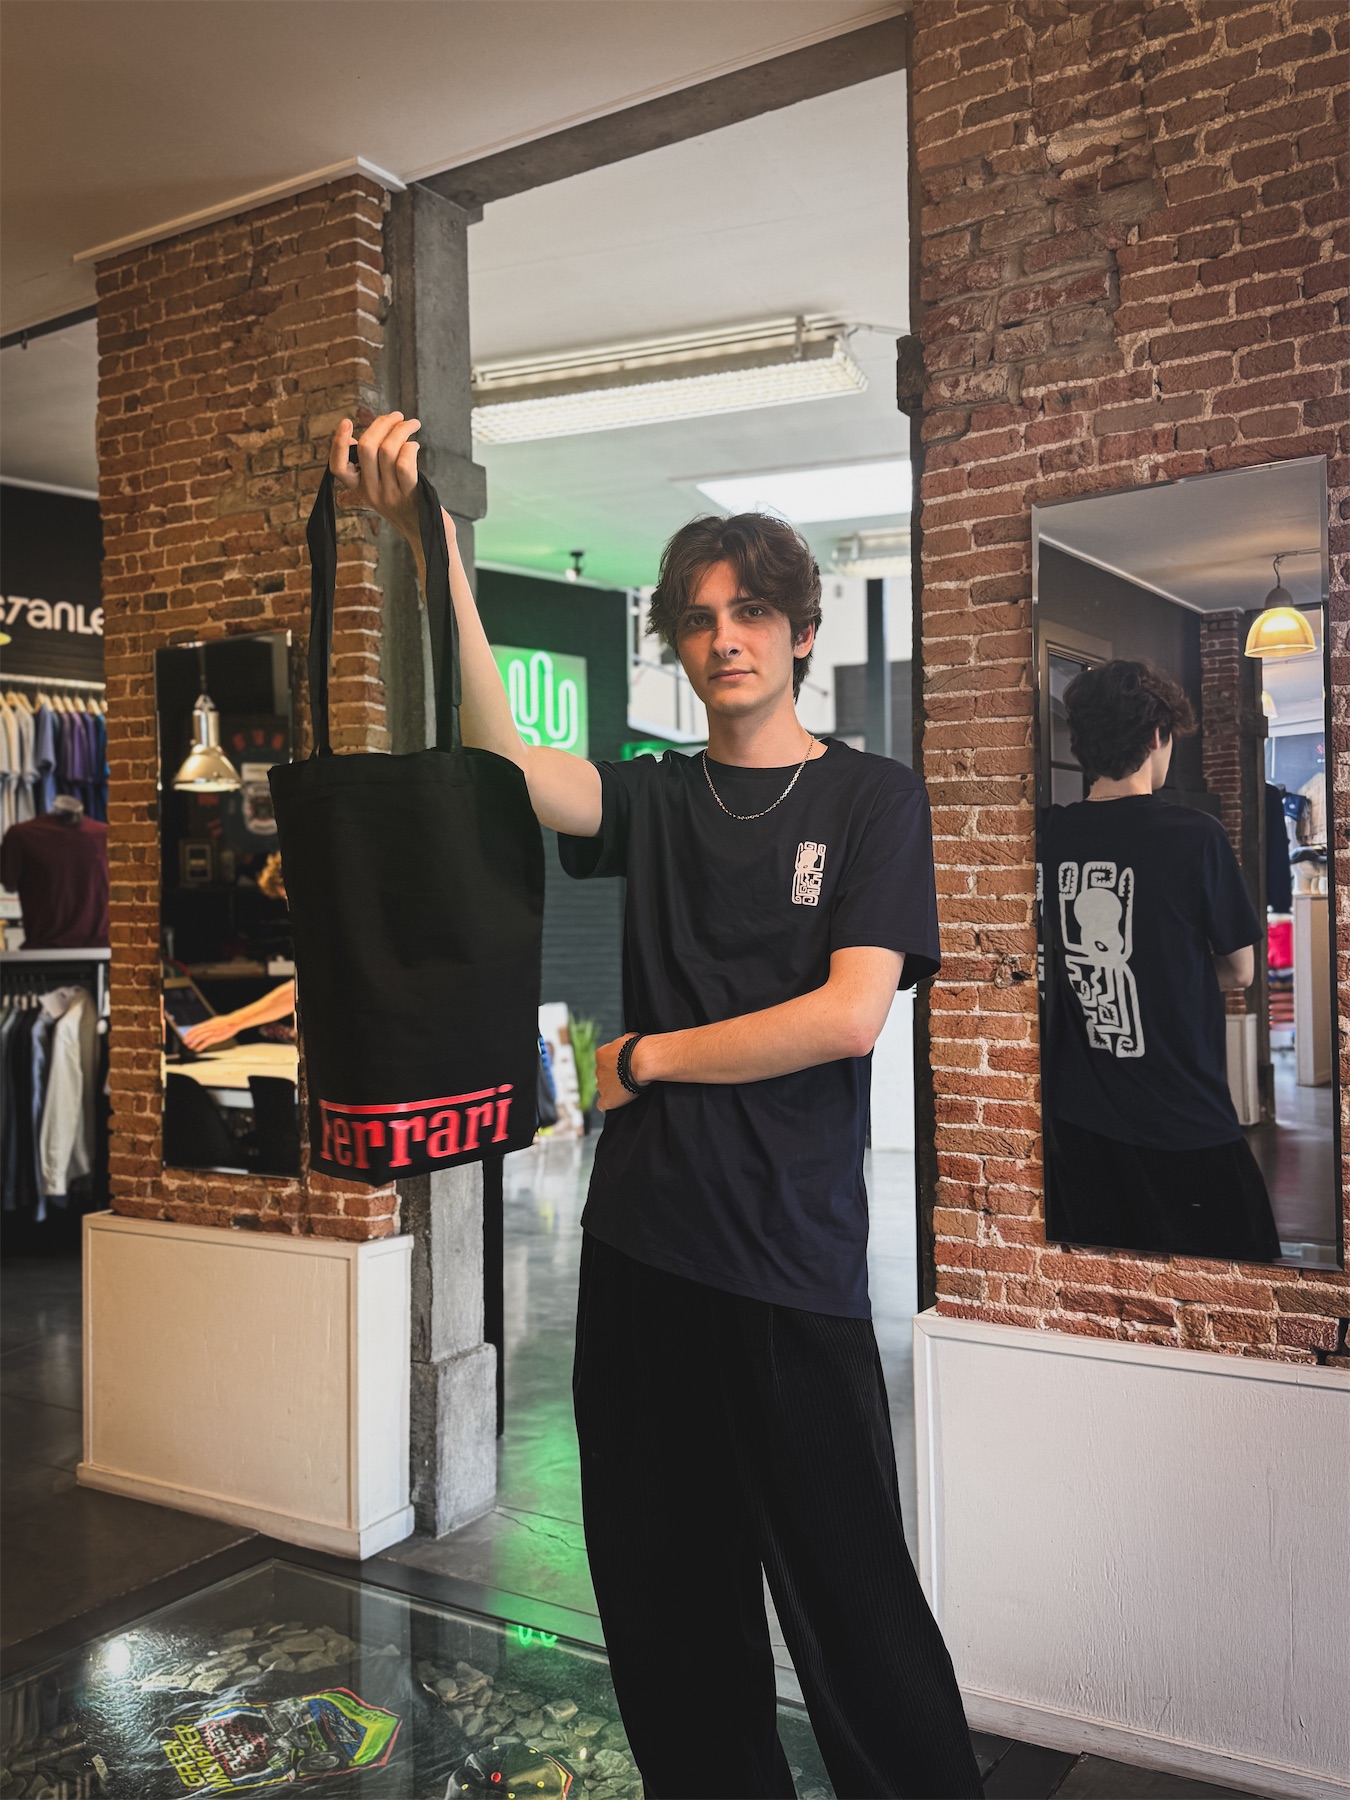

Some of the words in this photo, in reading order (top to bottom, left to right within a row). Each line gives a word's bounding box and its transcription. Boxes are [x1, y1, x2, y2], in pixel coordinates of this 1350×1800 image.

[319, 1083, 514, 1169] Ferrari
[160, 1740, 206, 1787] GREEN
[174, 1723, 234, 1789] MONSTER
